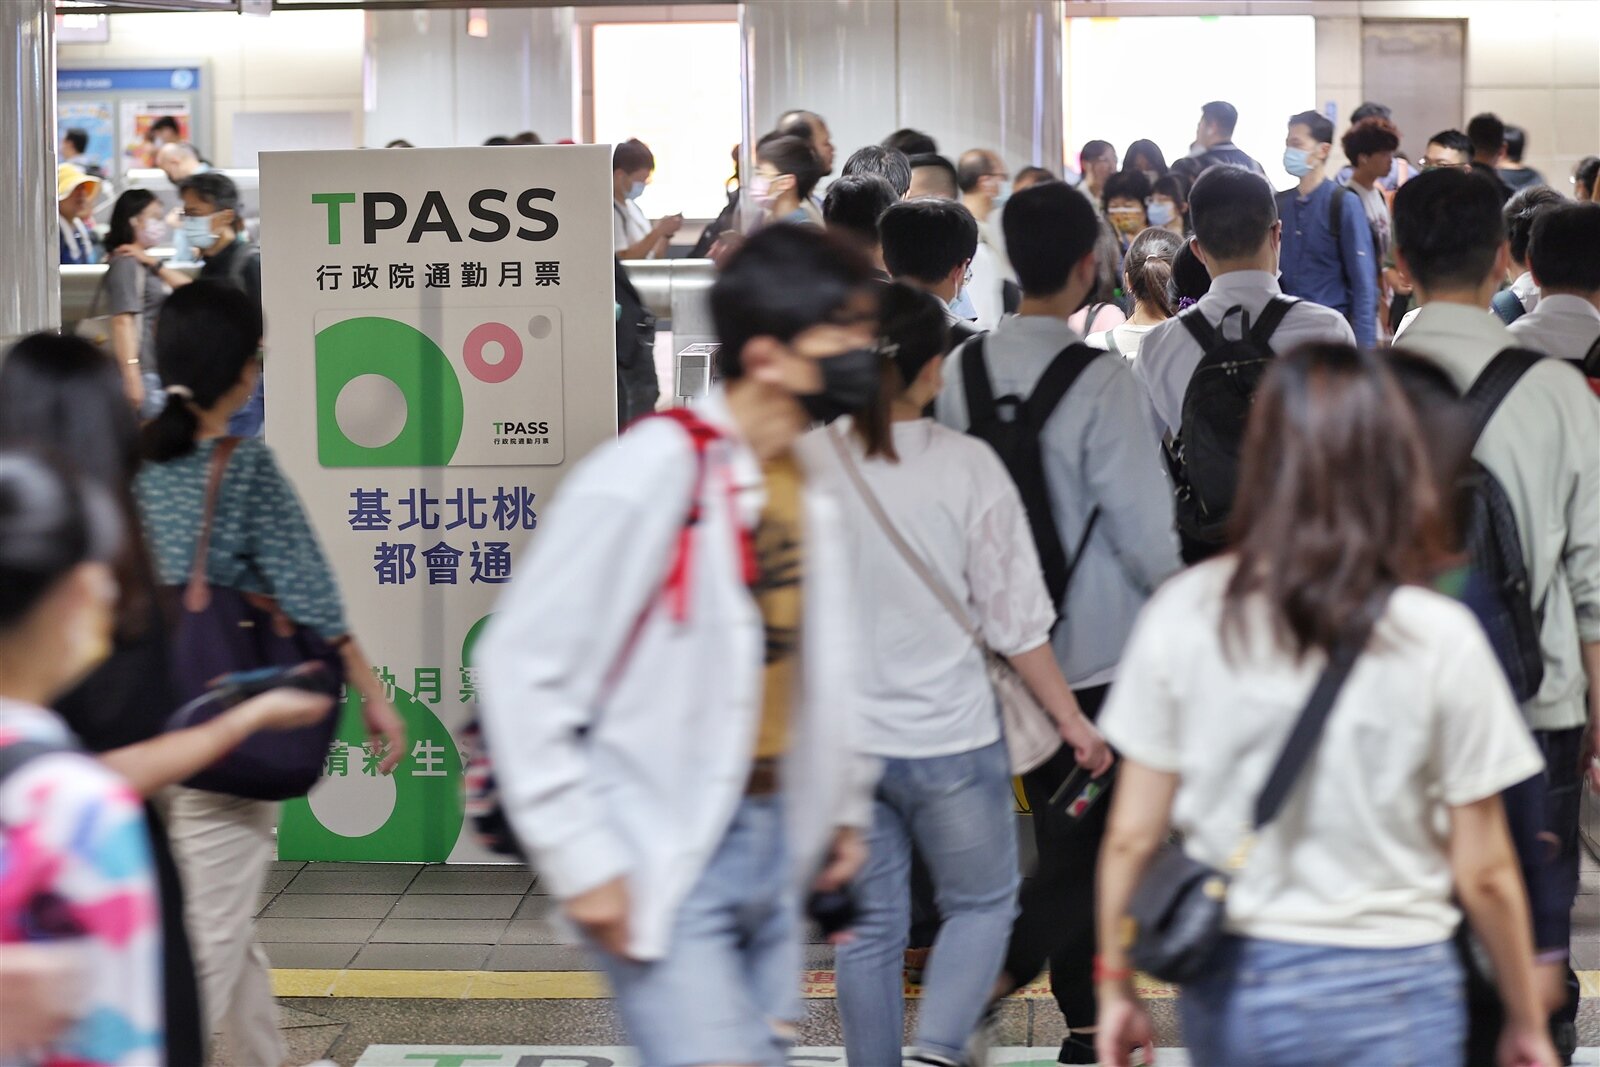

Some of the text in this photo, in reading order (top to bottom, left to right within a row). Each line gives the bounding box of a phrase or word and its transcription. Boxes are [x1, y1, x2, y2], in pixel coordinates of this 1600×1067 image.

[311, 187, 559, 245] TPASS
[315, 260, 562, 291] 行政院通勤月票
[492, 421, 549, 435] TPASS
[493, 437, 550, 445] 行政院通勤月票
[348, 486, 538, 531] 基北北桃
[373, 540, 514, 585] 都會通
